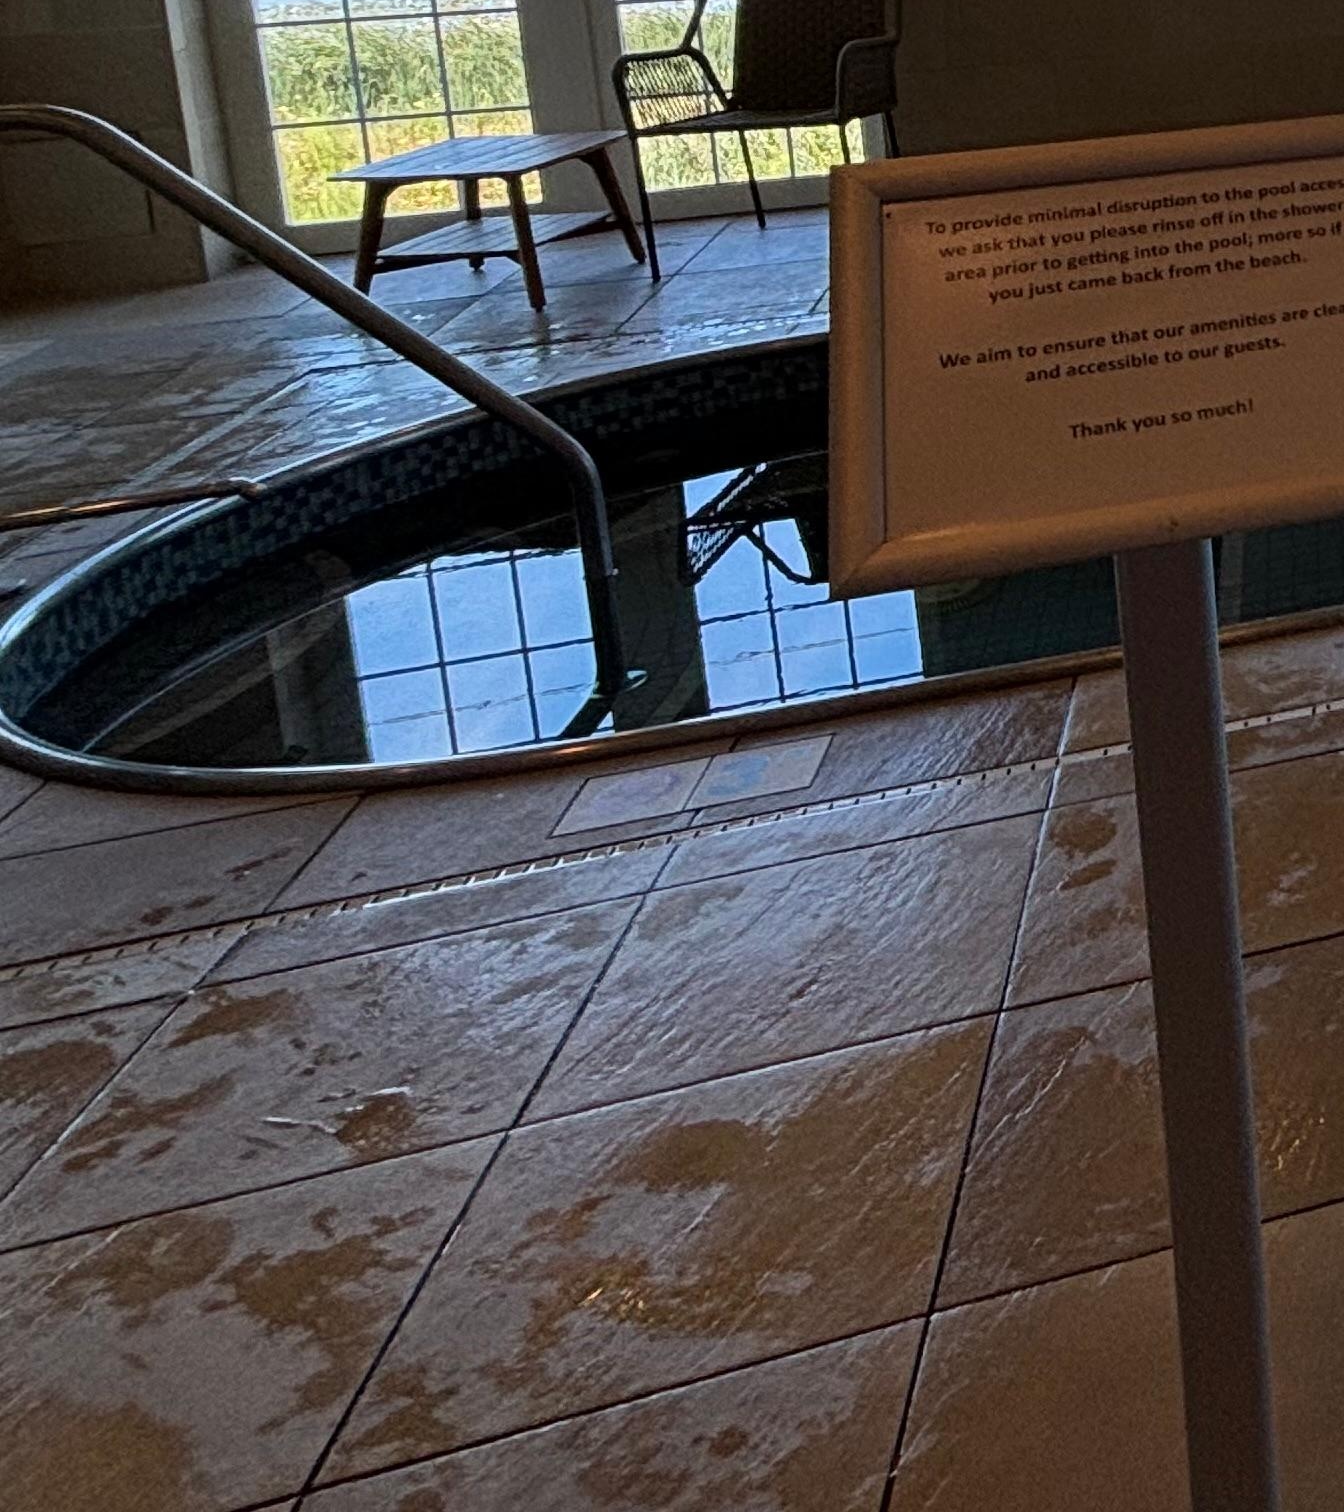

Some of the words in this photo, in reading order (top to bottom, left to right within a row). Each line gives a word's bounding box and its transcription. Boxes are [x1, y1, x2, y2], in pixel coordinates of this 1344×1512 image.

[925, 221, 946, 235] To
[952, 213, 1023, 236] provide
[1028, 202, 1102, 225] minimal
[1107, 194, 1197, 215] disruption
[1202, 192, 1220, 204] to
[1225, 187, 1253, 200] the
[1258, 181, 1295, 200] pool
[938, 245, 967, 258] we
[972, 239, 1003, 254] ask
[1006, 233, 1045, 250] that
[1051, 230, 1085, 247] you
[1090, 223, 1147, 242] please
[1153, 218, 1195, 233] rinse
[1201, 212, 1224, 226] off
[1229, 210, 1245, 224] in
[1250, 207, 1278, 221] the
[1282, 201, 1344, 218] shower
[945, 267, 986, 282] area
[992, 259, 1037, 279] prior
[1043, 257, 1062, 270] to
[1067, 250, 1130, 271] getting
[1134, 243, 1169, 259] into
[1175, 239, 1204, 254] the
[1209, 232, 1253, 252] pool;
[1258, 230, 1303, 245] more
[1307, 225, 1326, 237] so
[1331, 221, 1343, 236] if
[989, 287, 1024, 304] you
[1028, 281, 1063, 299] just
[1068, 275, 1117, 292] came
[1122, 267, 1164, 285] back
[1168, 264, 1211, 279] from
[1215, 258, 1245, 273] the
[1250, 250, 1308, 269] beach.
[939, 352, 971, 369] We
[976, 347, 1012, 364] aim
[1017, 345, 1037, 358] to
[1043, 336, 1106, 355] ensure
[1111, 328, 1148, 345] that
[1153, 326, 1184, 340] our
[1190, 314, 1277, 335] amenities
[1282, 308, 1309, 323] are
[1025, 364, 1061, 383] and
[1066, 352, 1159, 378] accessible
[1165, 350, 1183, 363] to
[1188, 346, 1218, 361] our
[1224, 337, 1286, 359] guests.
[1069, 417, 1127, 438] Thank
[1132, 415, 1166, 432] you
[1171, 411, 1192, 424] so
[1197, 398, 1254, 420] much!
